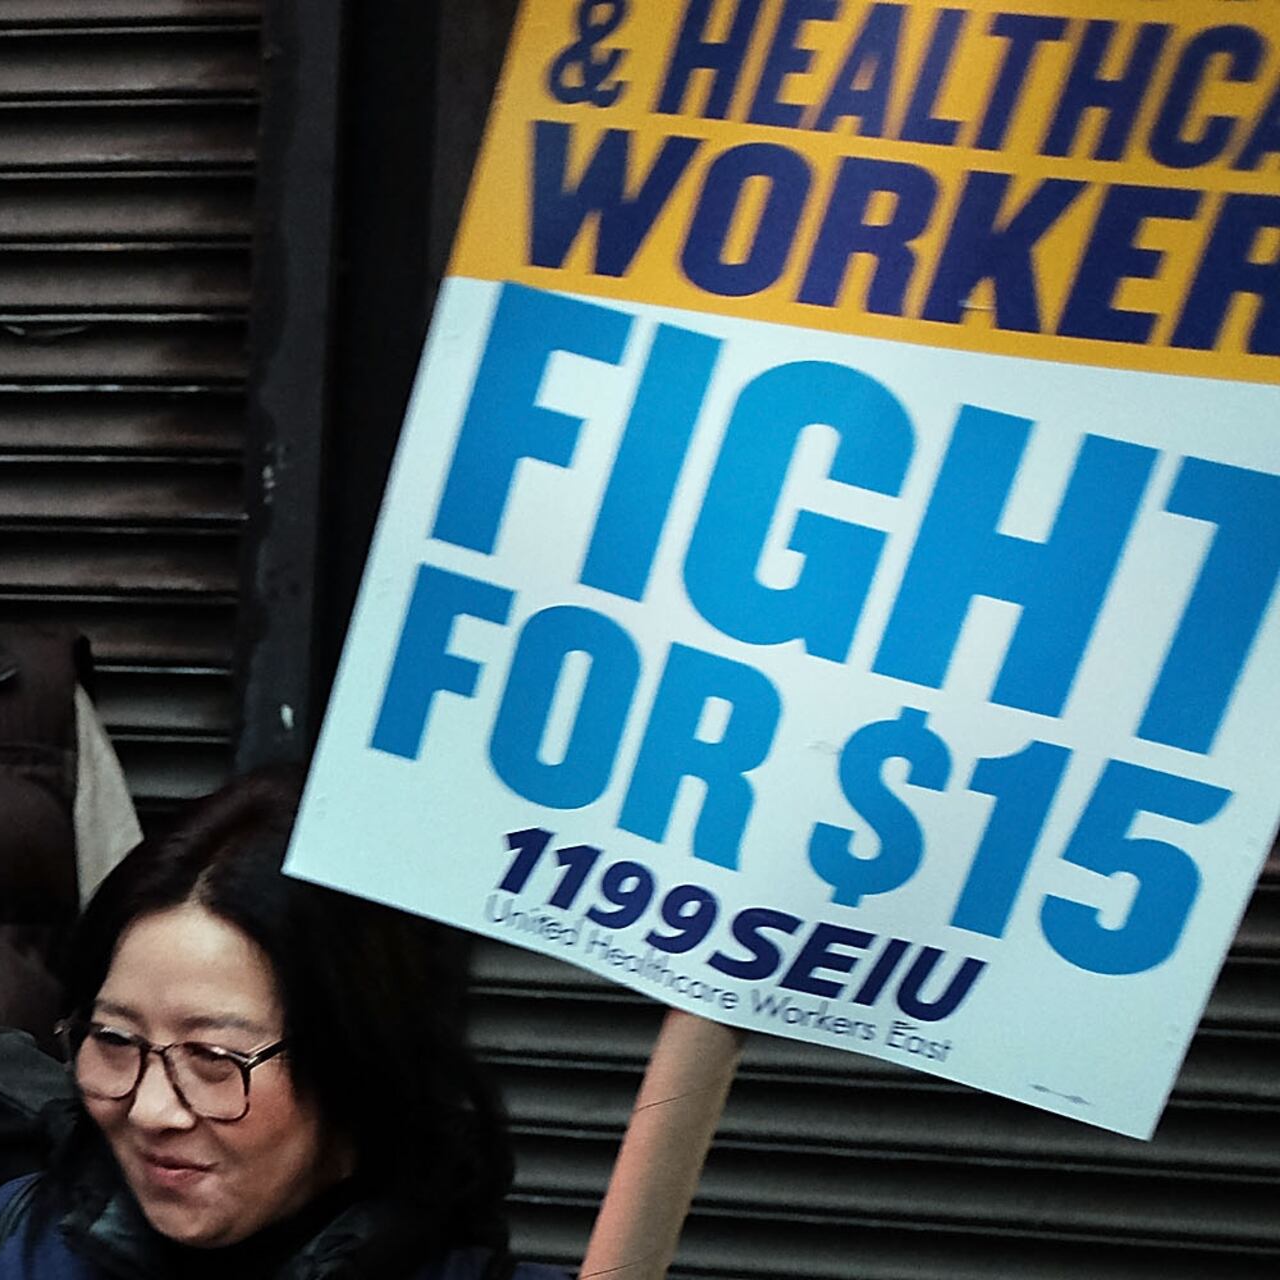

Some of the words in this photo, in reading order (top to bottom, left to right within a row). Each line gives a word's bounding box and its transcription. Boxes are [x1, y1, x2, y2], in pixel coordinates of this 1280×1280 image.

[547, 0, 628, 107] &
[430, 283, 1280, 756] FIGHT
[370, 563, 783, 872] FOR
[807, 706, 1236, 977] $15
[484, 894, 578, 947] United
[586, 928, 740, 1012] Healthcare
[750, 989, 877, 1042] Workers
[887, 1022, 954, 1064] East
[498, 827, 989, 1023] 1199SEIU
